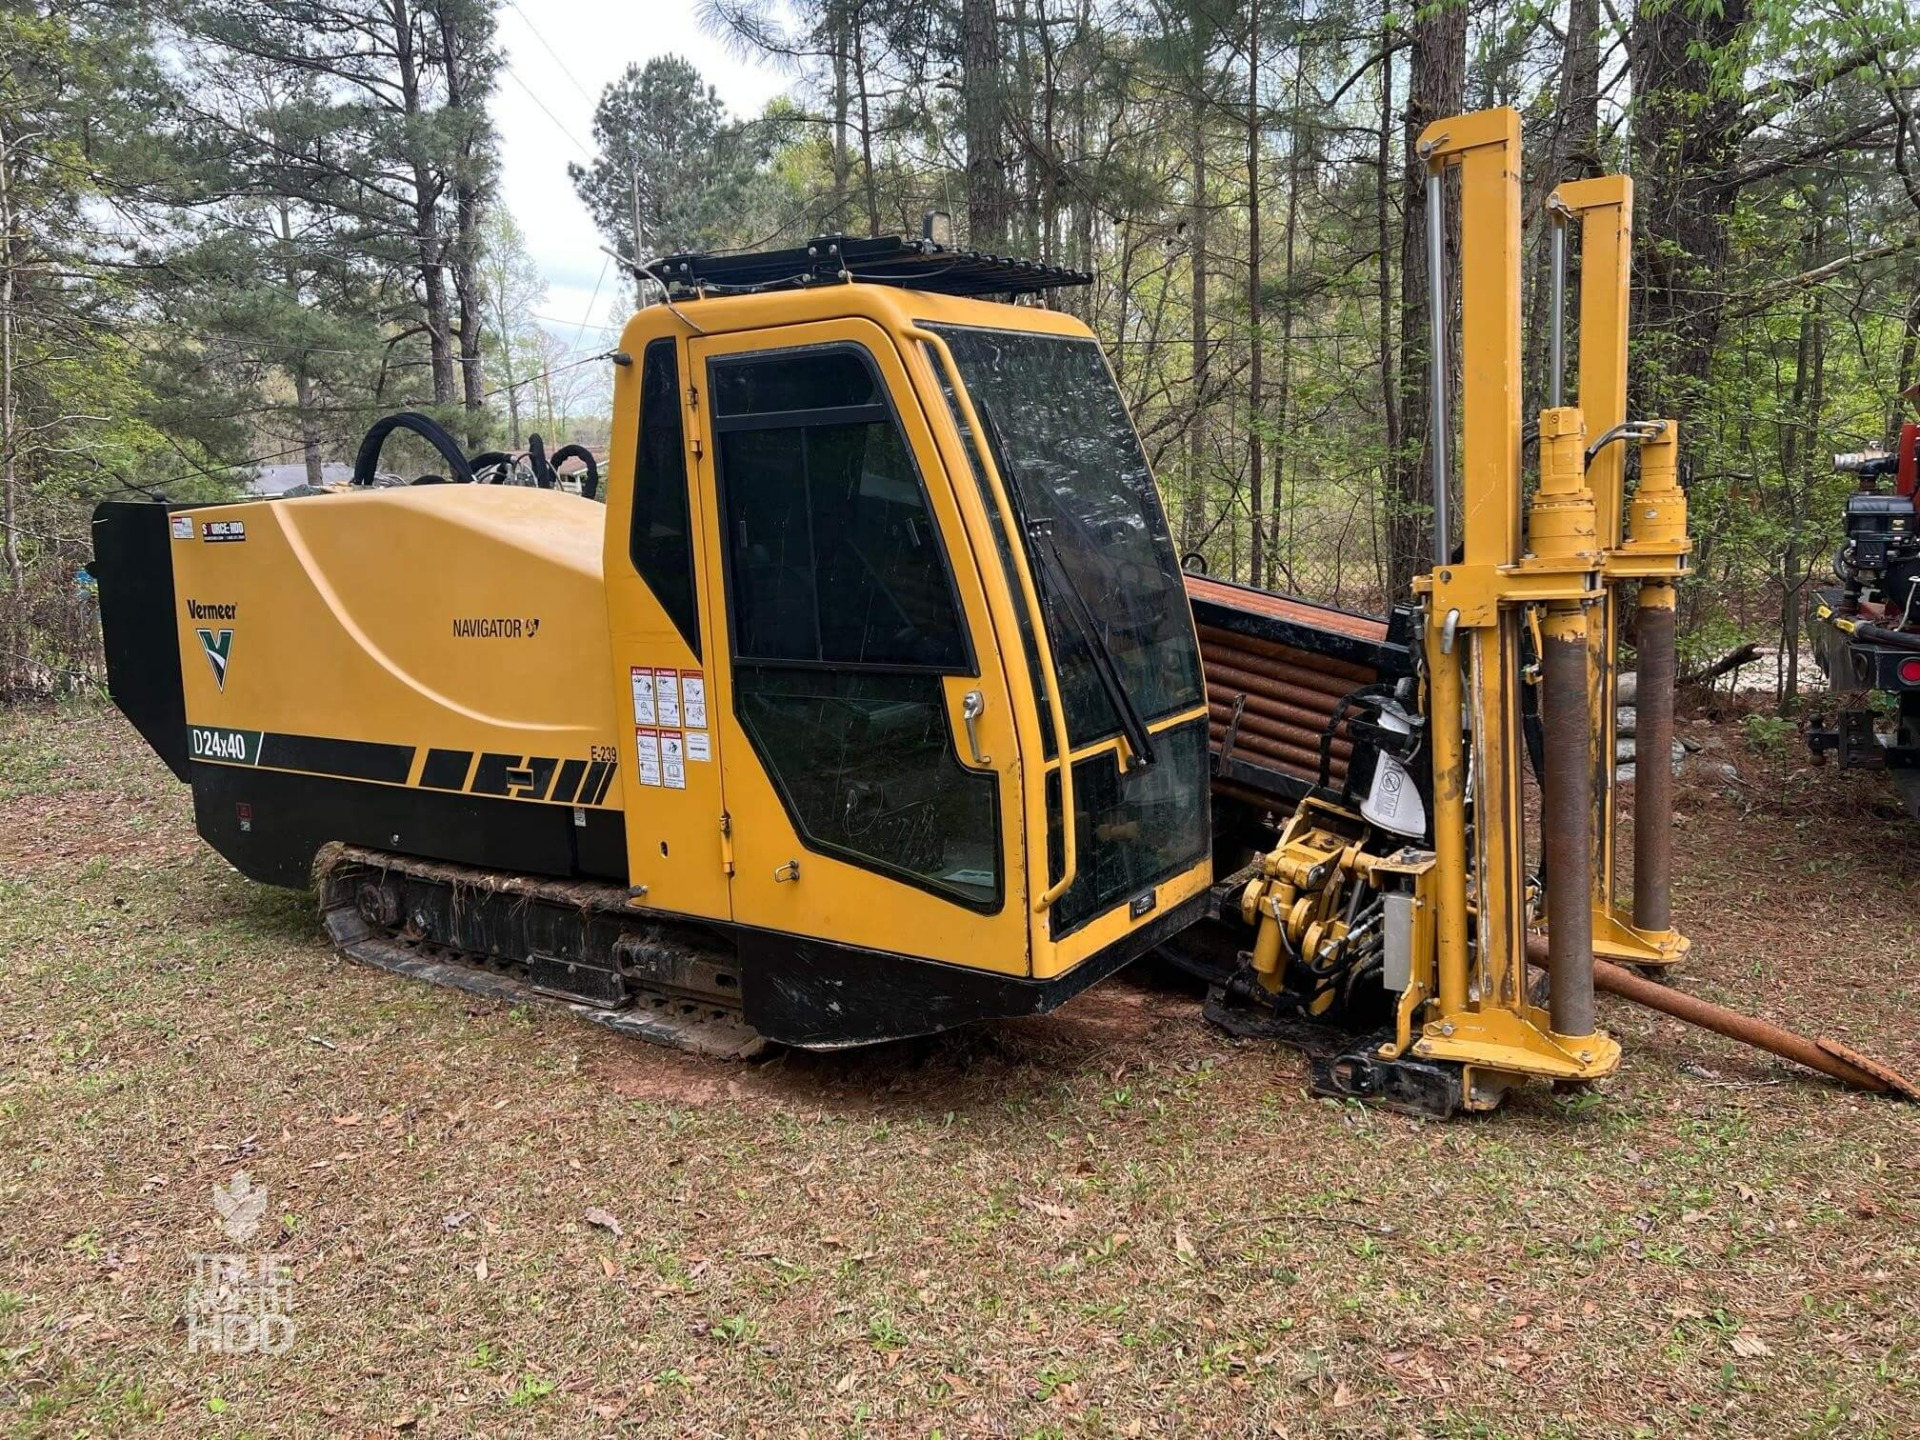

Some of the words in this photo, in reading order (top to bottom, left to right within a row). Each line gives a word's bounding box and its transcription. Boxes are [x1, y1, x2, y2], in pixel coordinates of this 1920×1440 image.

[187, 599, 237, 620] Vermeer
[453, 618, 522, 638] NAVIGATOR
[193, 729, 246, 759] D24x40
[591, 746, 617, 762] E-239
